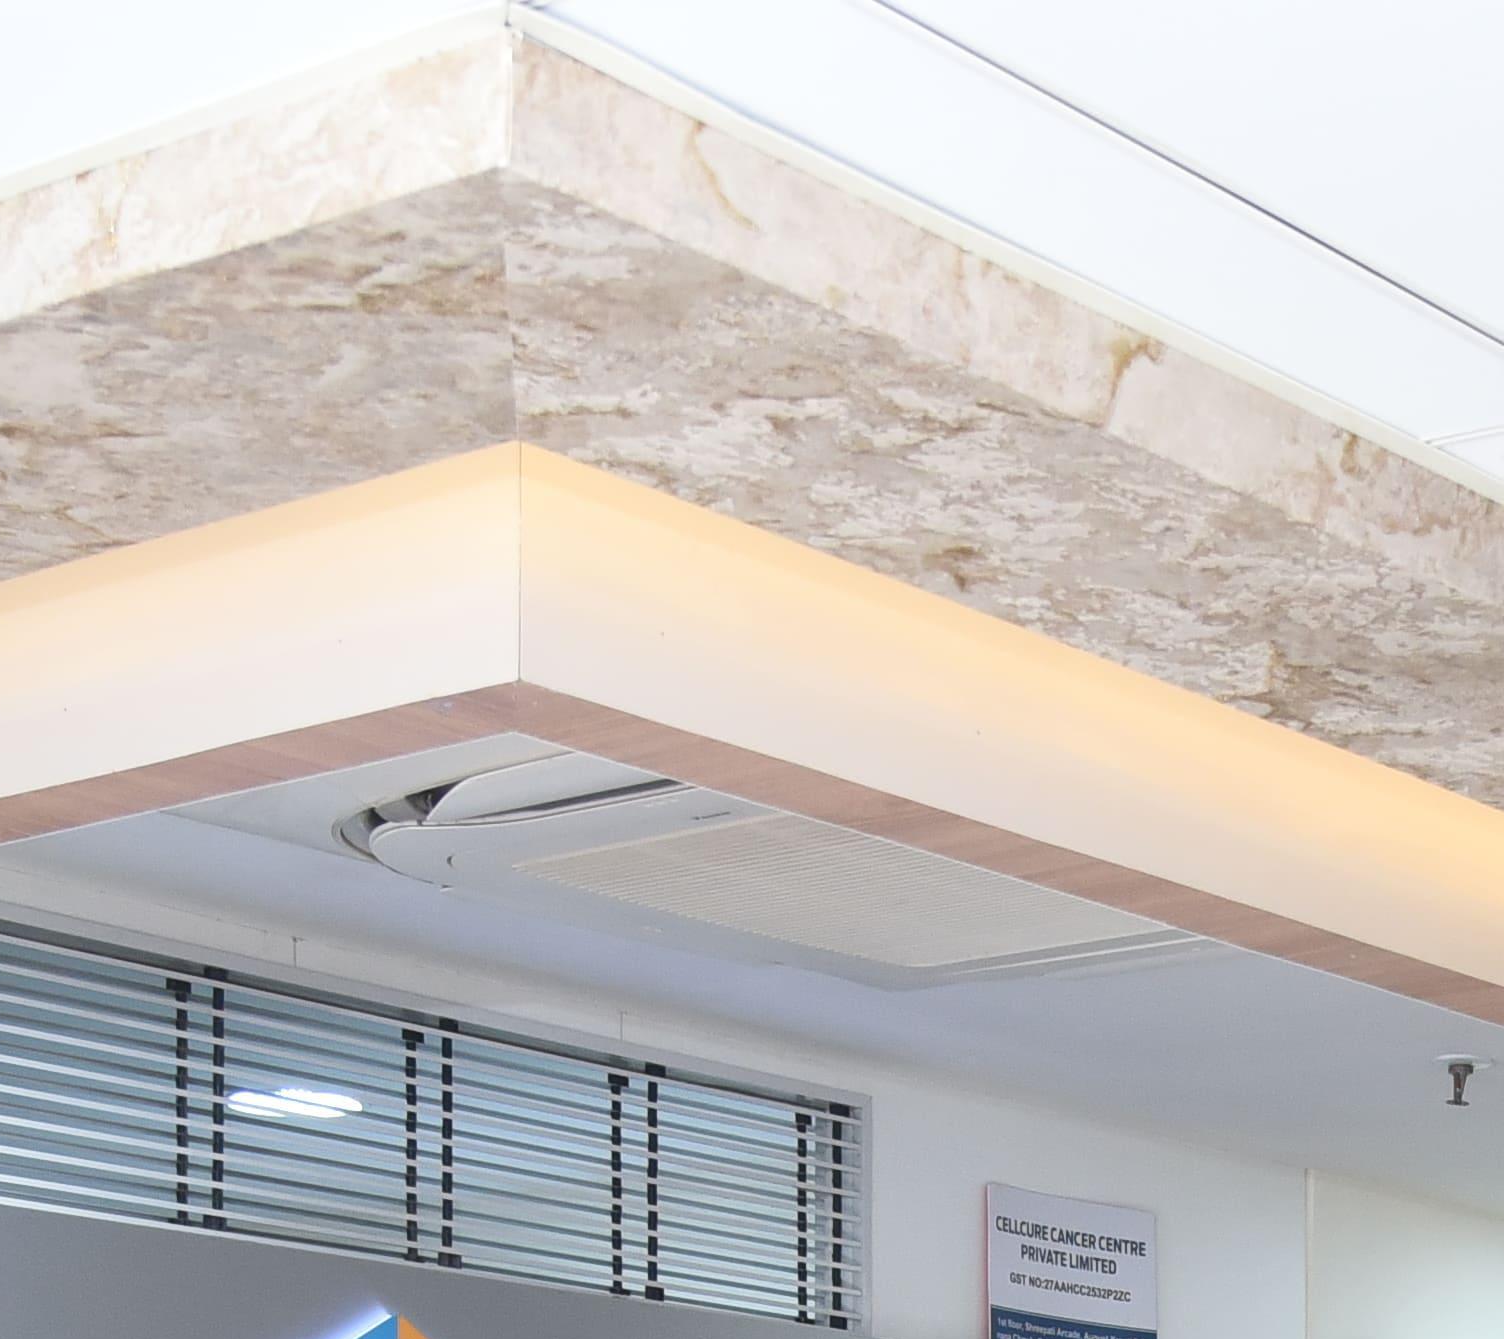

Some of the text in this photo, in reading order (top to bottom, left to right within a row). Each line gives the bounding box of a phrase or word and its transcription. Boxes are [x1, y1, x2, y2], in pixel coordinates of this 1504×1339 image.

[996, 1215, 1147, 1257] CELLCURE CANCER CENTRE
[1021, 1244, 1117, 1275] PRIVATE LIMITED
[1009, 1272, 1027, 1284] GST
